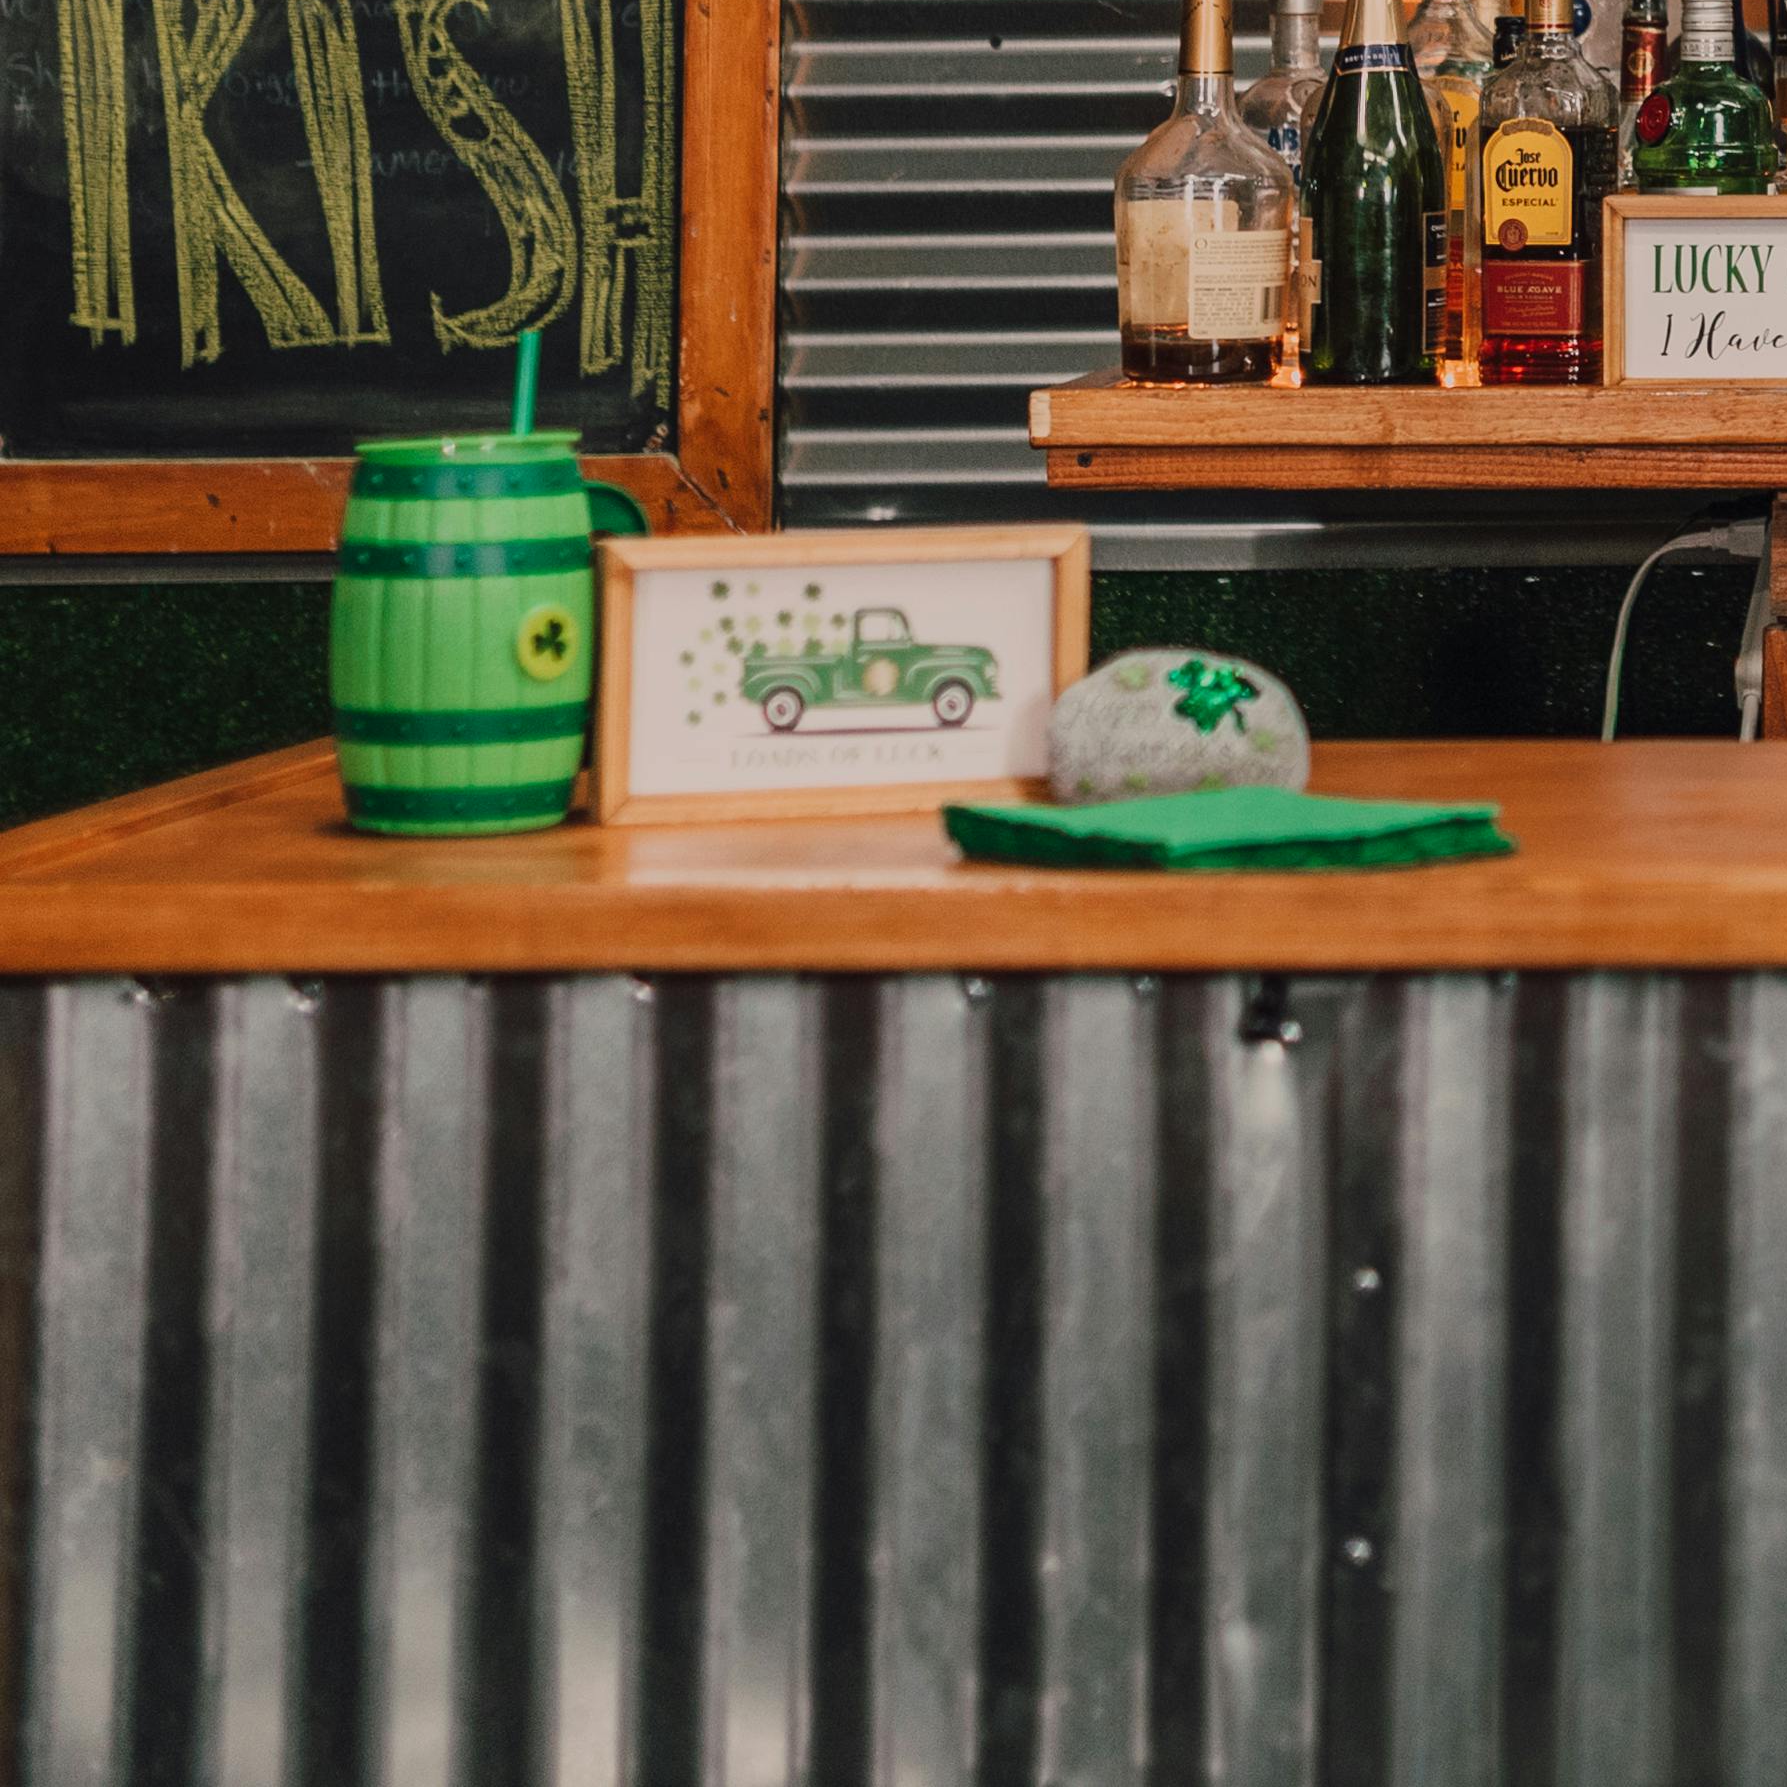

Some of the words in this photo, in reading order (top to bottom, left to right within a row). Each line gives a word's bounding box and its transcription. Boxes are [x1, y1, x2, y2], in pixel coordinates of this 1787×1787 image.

[1514, 147, 1542, 166] Jose
[1495, 159, 1559, 193] Cuervo
[1502, 197, 1557, 208] ESPECIAL
[1652, 243, 1774, 294] LUCKY
[1660, 313, 1674, 357] I
